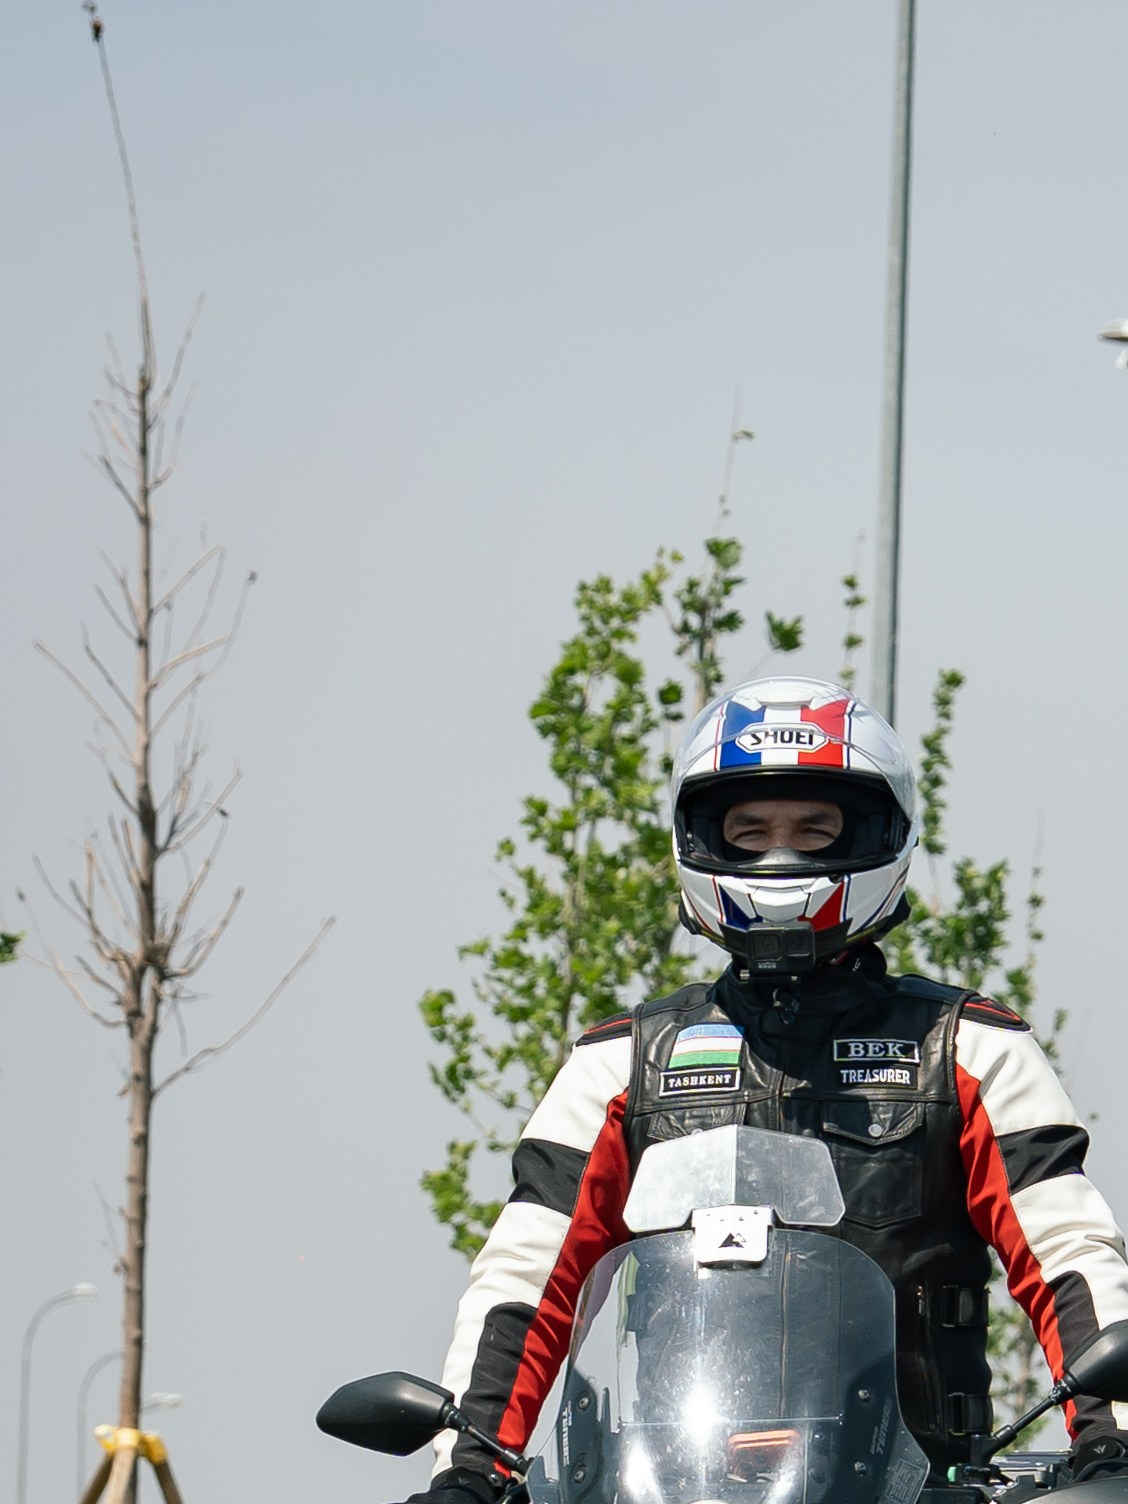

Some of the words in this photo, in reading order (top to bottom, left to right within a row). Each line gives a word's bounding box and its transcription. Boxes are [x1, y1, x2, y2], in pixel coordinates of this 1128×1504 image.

[750, 728, 814, 746] SHOEI
[847, 1042, 906, 1058] BEK
[667, 1073, 732, 1088] TASHKENT
[840, 1068, 911, 1085] TREASURER
